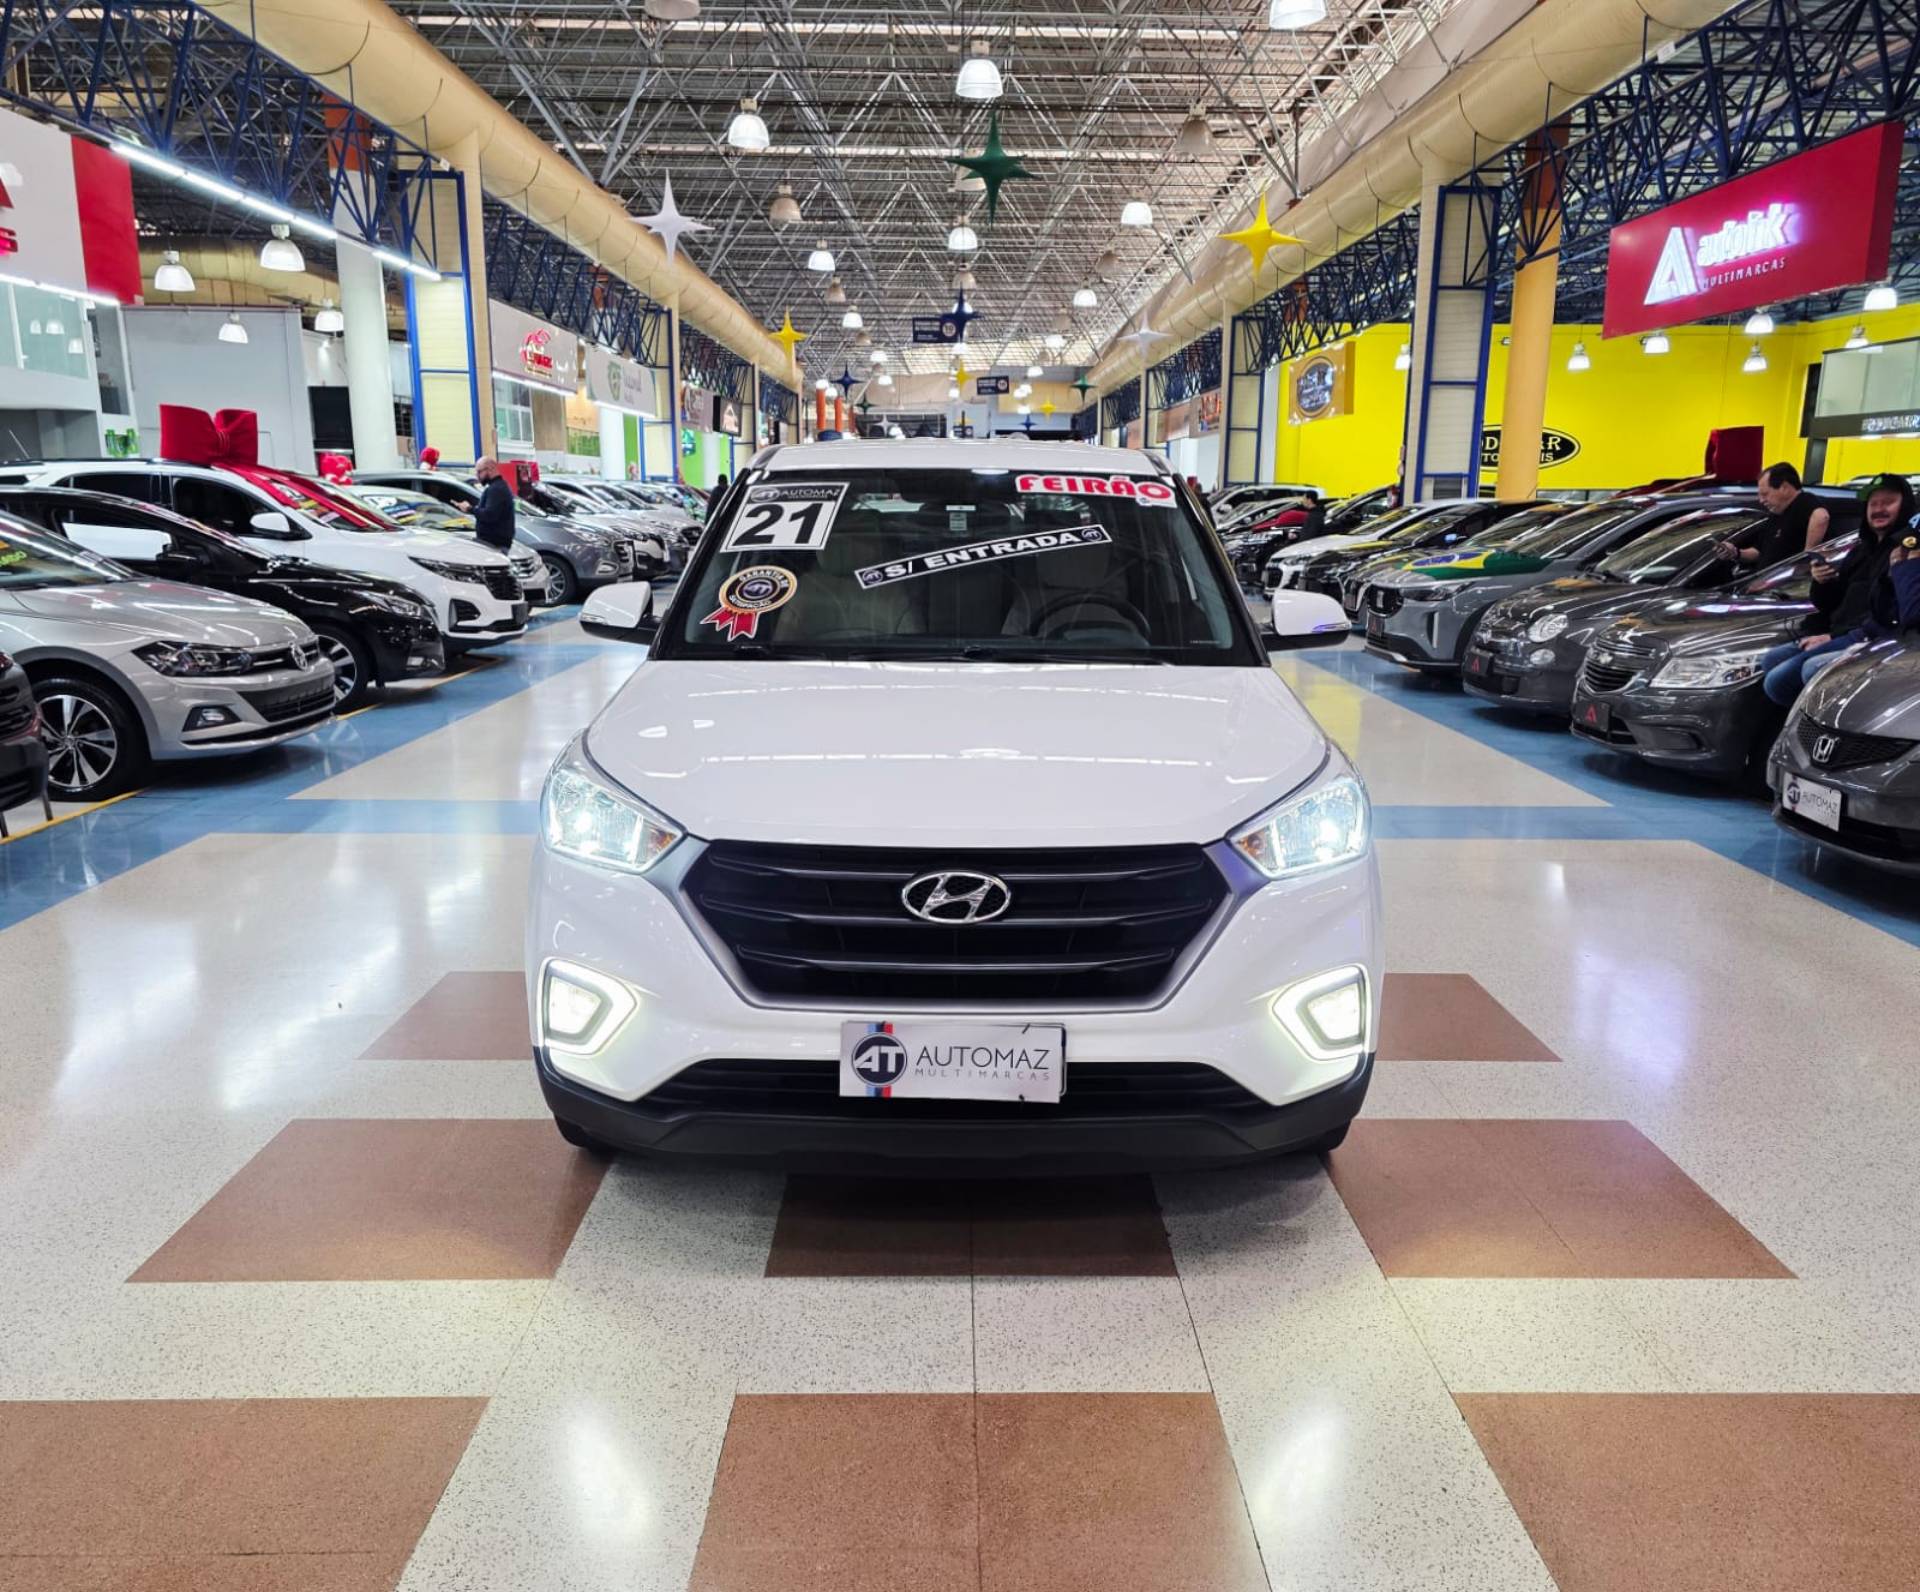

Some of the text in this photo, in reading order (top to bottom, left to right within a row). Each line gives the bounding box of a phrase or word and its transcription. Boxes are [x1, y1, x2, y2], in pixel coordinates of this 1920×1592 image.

[1703, 256, 1786, 289] MULTIMARCAS
[781, 488, 840, 498] AUTOMAZ
[1019, 475, 1172, 499] FEIRÃO
[731, 502, 823, 546] 21
[884, 532, 1082, 578] S/ ENTRADA
[916, 1046, 1050, 1070] AUTOMAZ
[914, 1068, 1050, 1081] MULTIMARCAS
